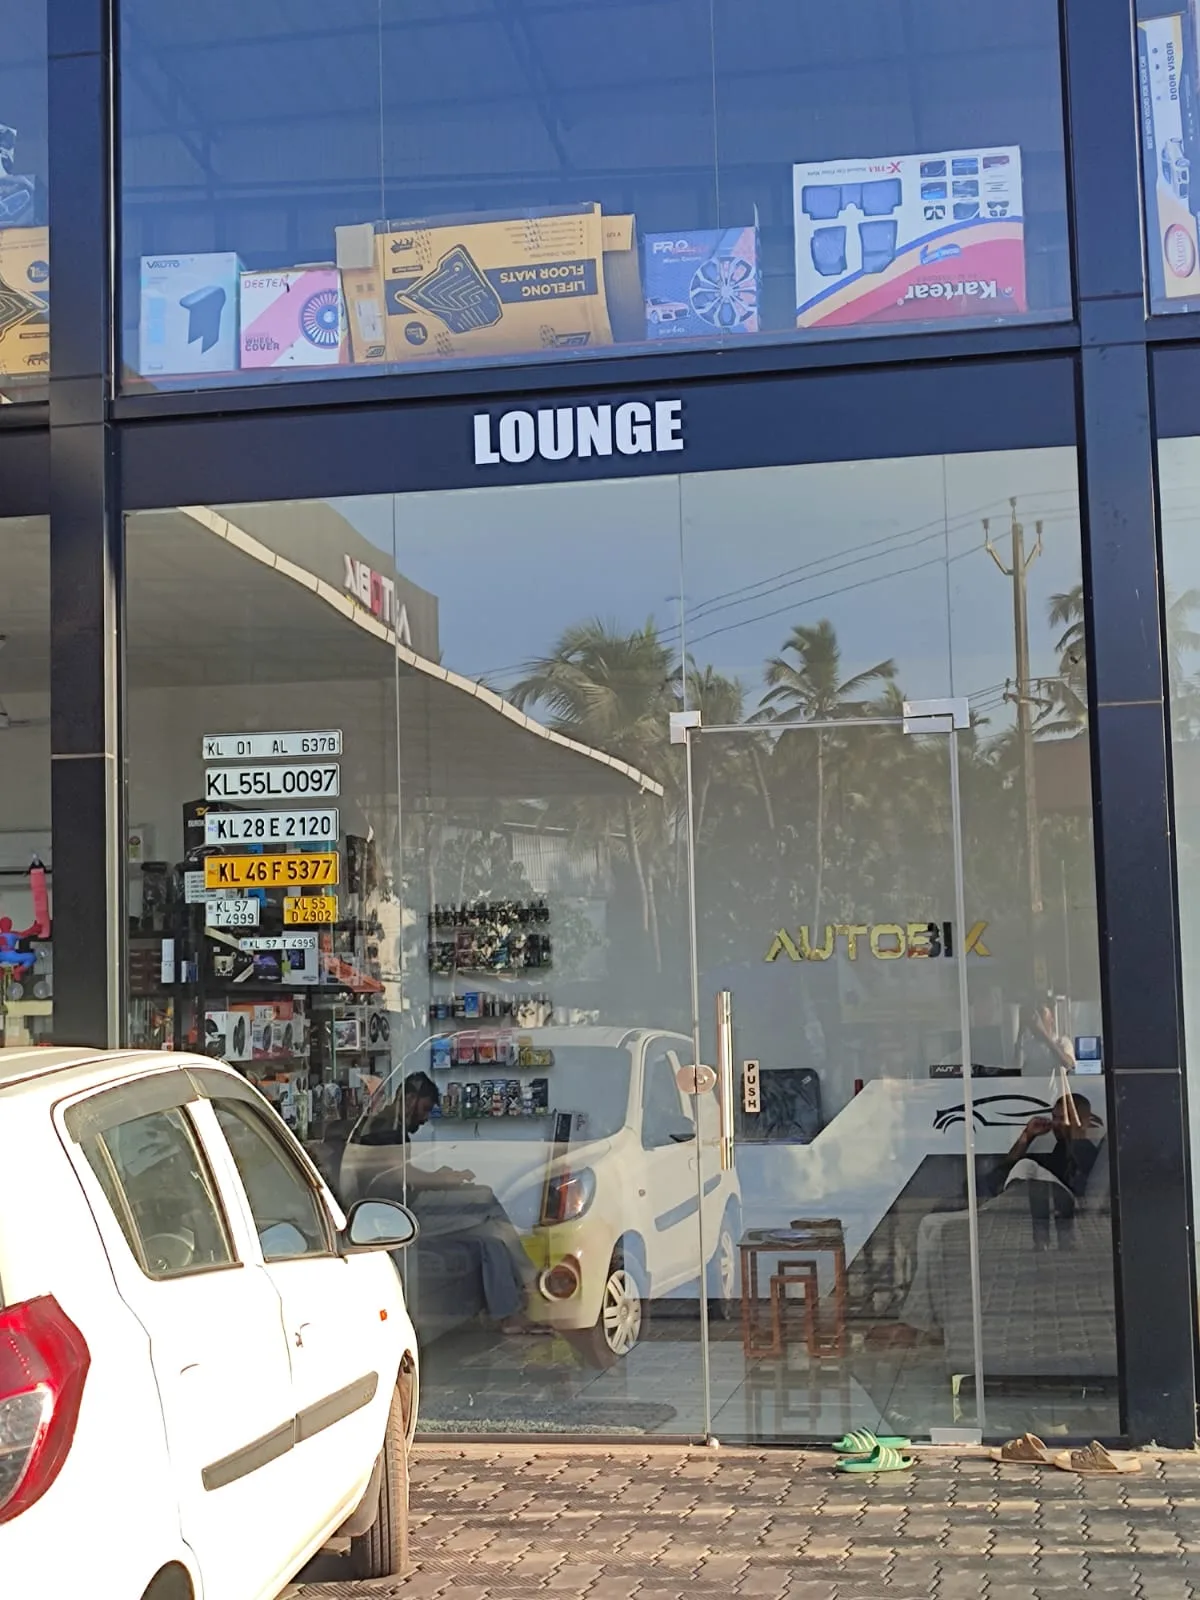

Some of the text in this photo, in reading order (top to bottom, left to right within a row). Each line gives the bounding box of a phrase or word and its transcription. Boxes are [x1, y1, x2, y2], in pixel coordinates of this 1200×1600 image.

[1166, 41, 1178, 101] DOOR VISOR
[500, 265, 584, 284] FLOOR MATS
[521, 281, 586, 297] LIFELONG
[904, 279, 998, 301] Kartear
[245, 342, 280, 352] COVER
[473, 399, 684, 465] LOUNGE
[207, 738, 336, 756] KL 01 AL 6378
[207, 769, 337, 796] KL55L0097
[286, 816, 331, 836] 2120
[219, 859, 332, 882] KL 46 F 5377
[216, 900, 248, 913] KL 57
[294, 898, 308, 910] KL
[215, 912, 254, 925] T 4999
[303, 910, 332, 922] 4902
[747, 1063, 757, 1108] PUSH
